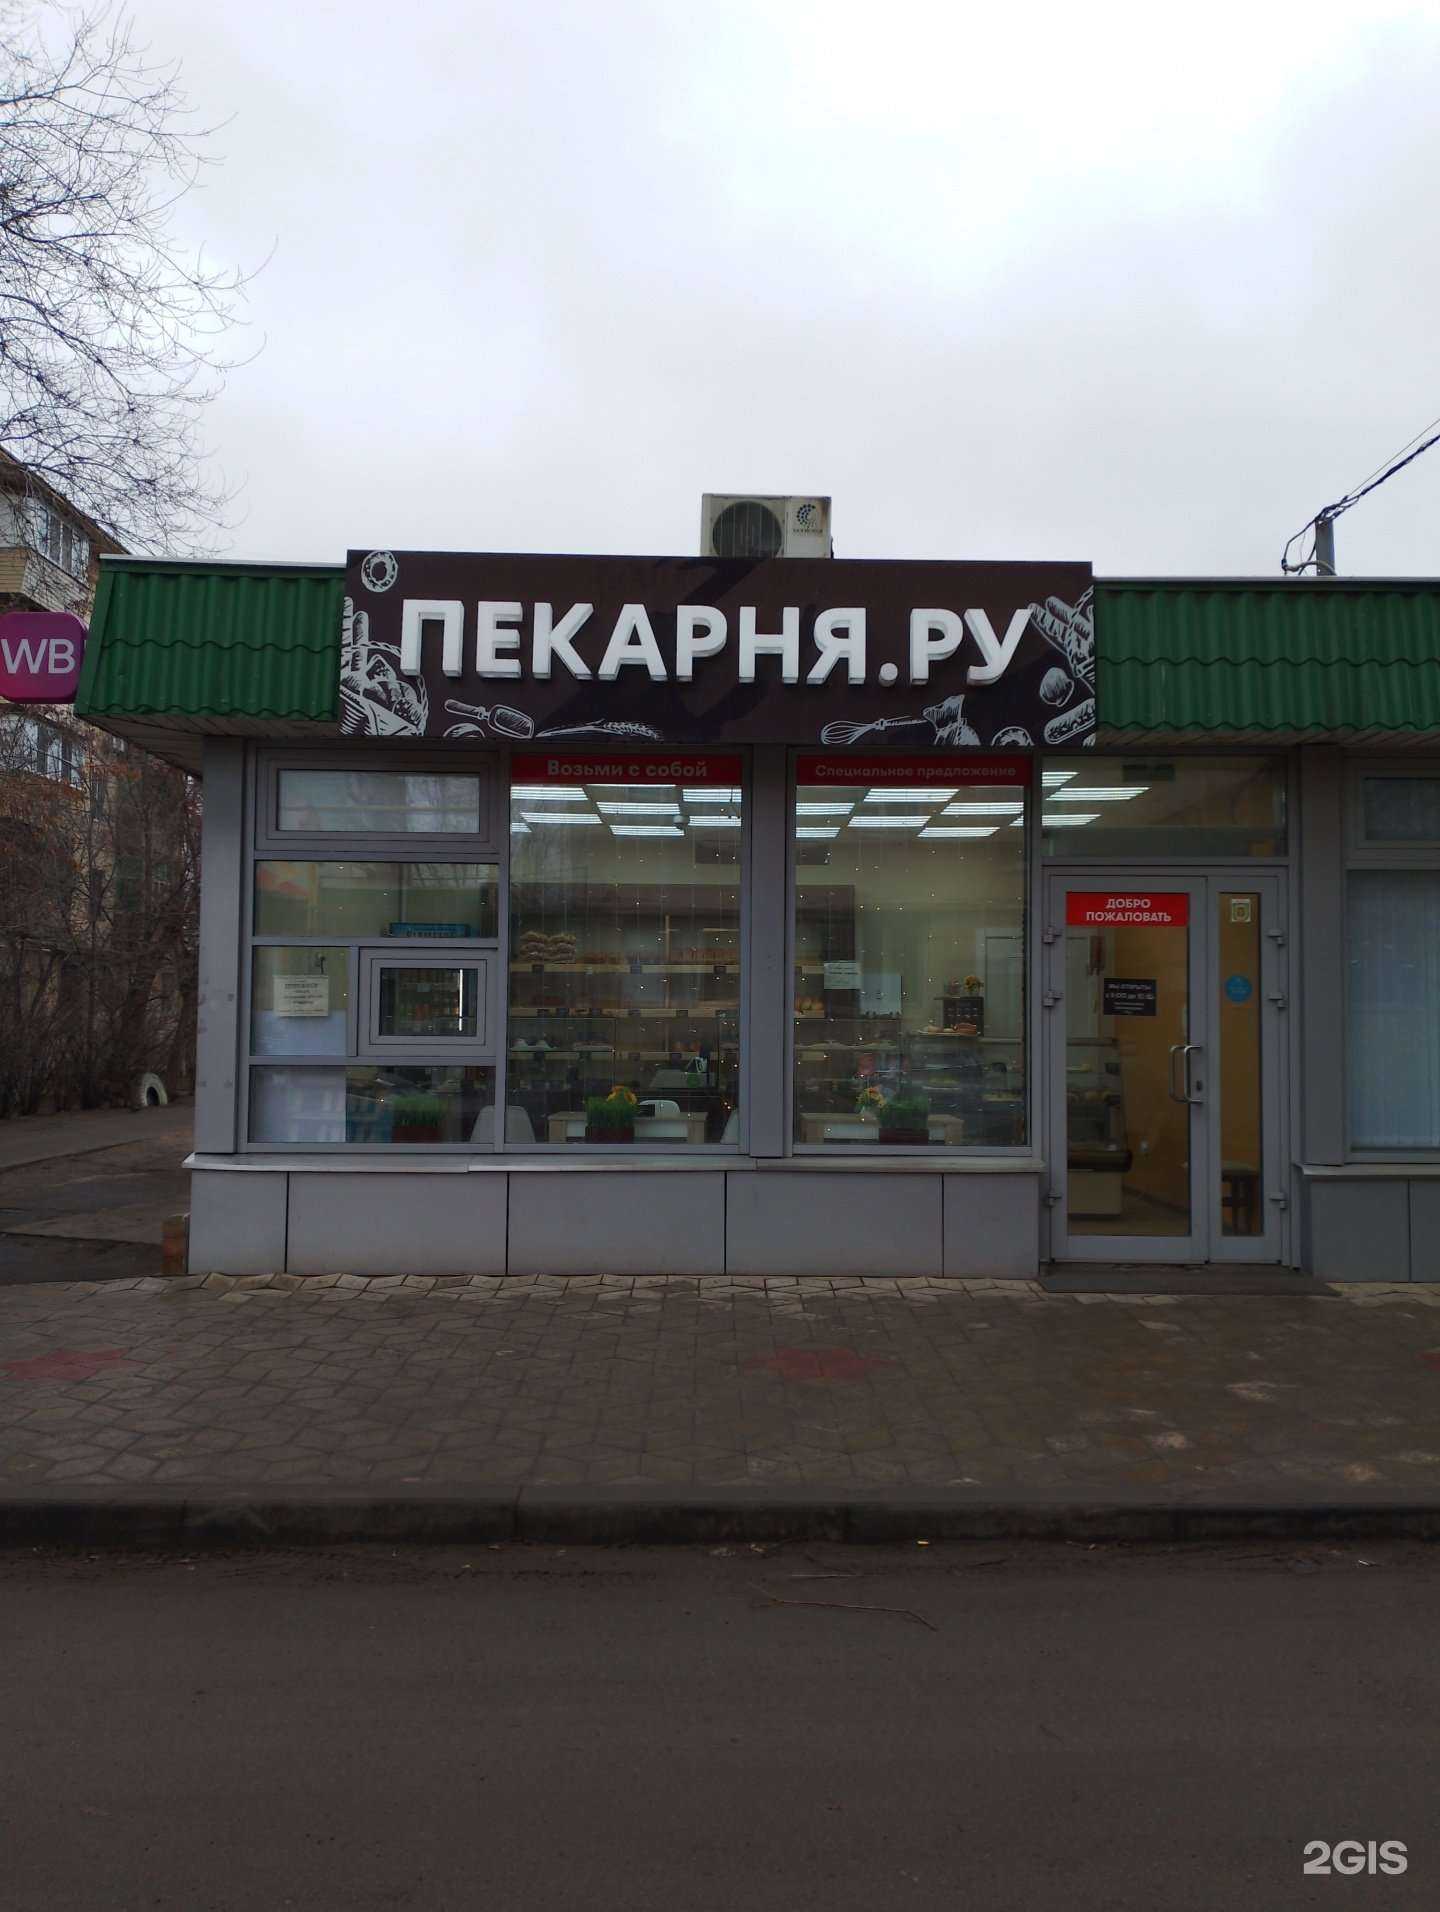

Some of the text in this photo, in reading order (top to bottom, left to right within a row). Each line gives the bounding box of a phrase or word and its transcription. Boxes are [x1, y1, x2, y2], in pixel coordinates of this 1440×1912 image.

[400, 599, 1033, 686] ПЕКАРНЯ.РУ
[0, 638, 76, 674] WB
[547, 759, 708, 777] Возьми с собой
[815, 764, 1017, 779] Специальное предложение
[1105, 898, 1151, 909] ДОБРО
[1086, 911, 1172, 922] ПОЖАЛОВАТЬ
